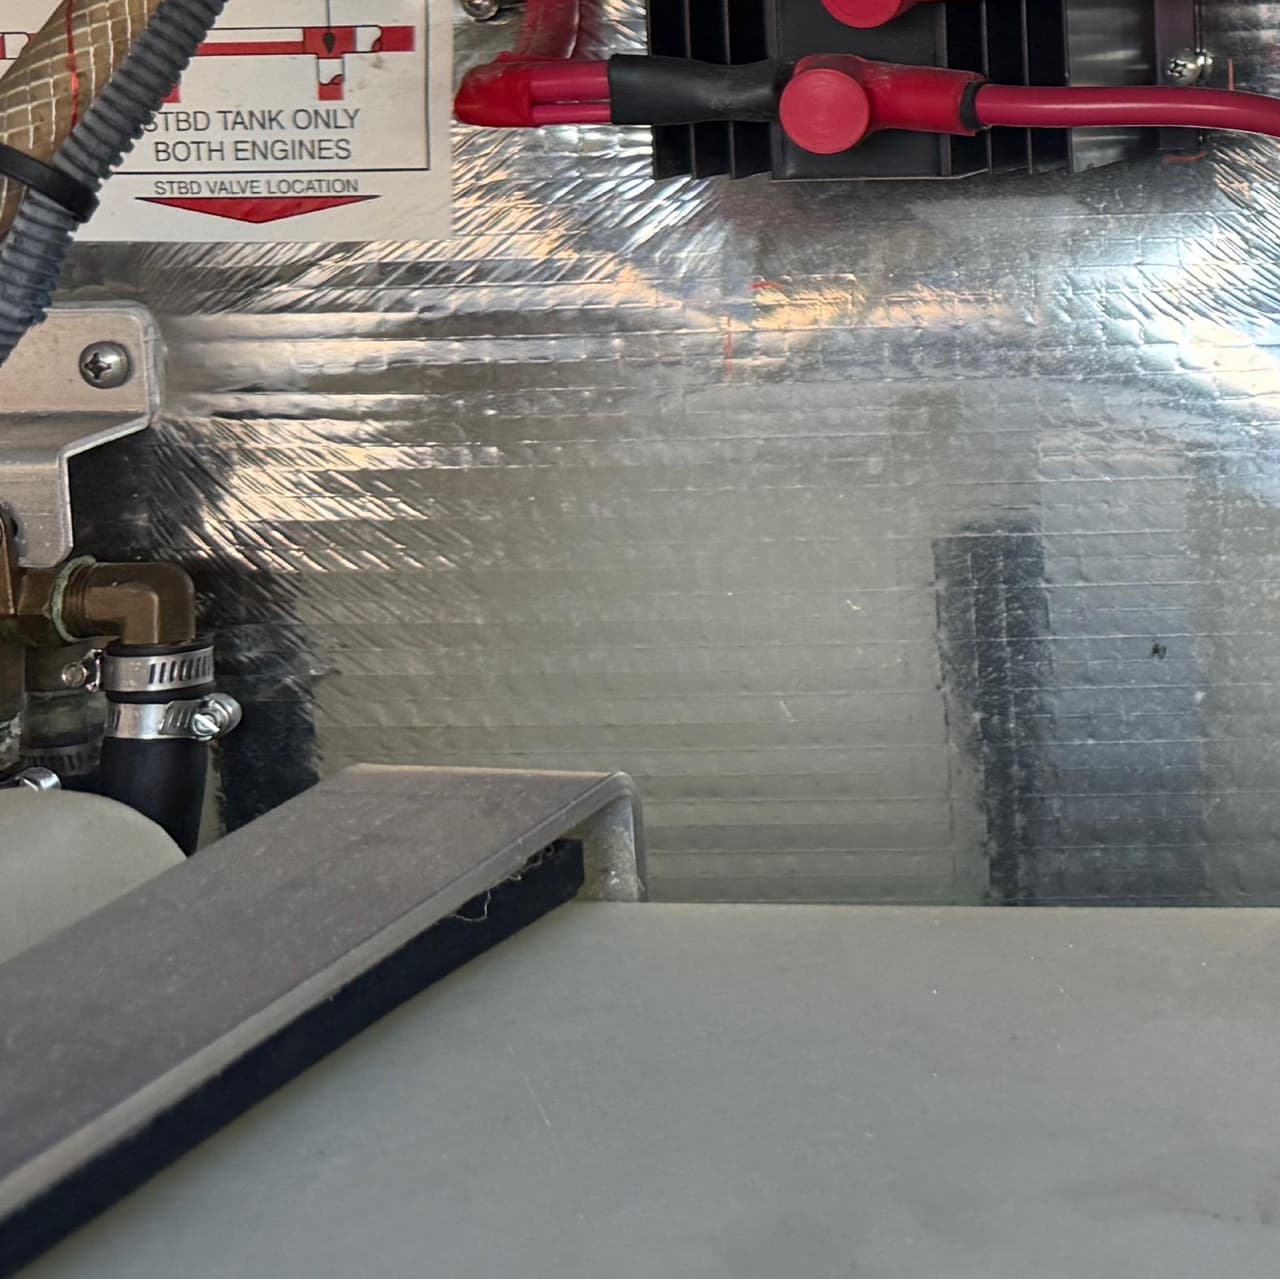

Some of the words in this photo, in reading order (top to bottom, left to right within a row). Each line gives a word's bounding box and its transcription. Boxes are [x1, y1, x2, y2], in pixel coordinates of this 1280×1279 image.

[145, 111, 211, 132] STBD
[216, 110, 285, 131] TANK
[293, 108, 360, 129] ONLY
[155, 142, 225, 162] BOTH
[234, 139, 352, 161] ENGINES
[154, 181, 201, 195] STBD
[206, 180, 261, 194] VALVE
[267, 179, 359, 193] LOCATION
